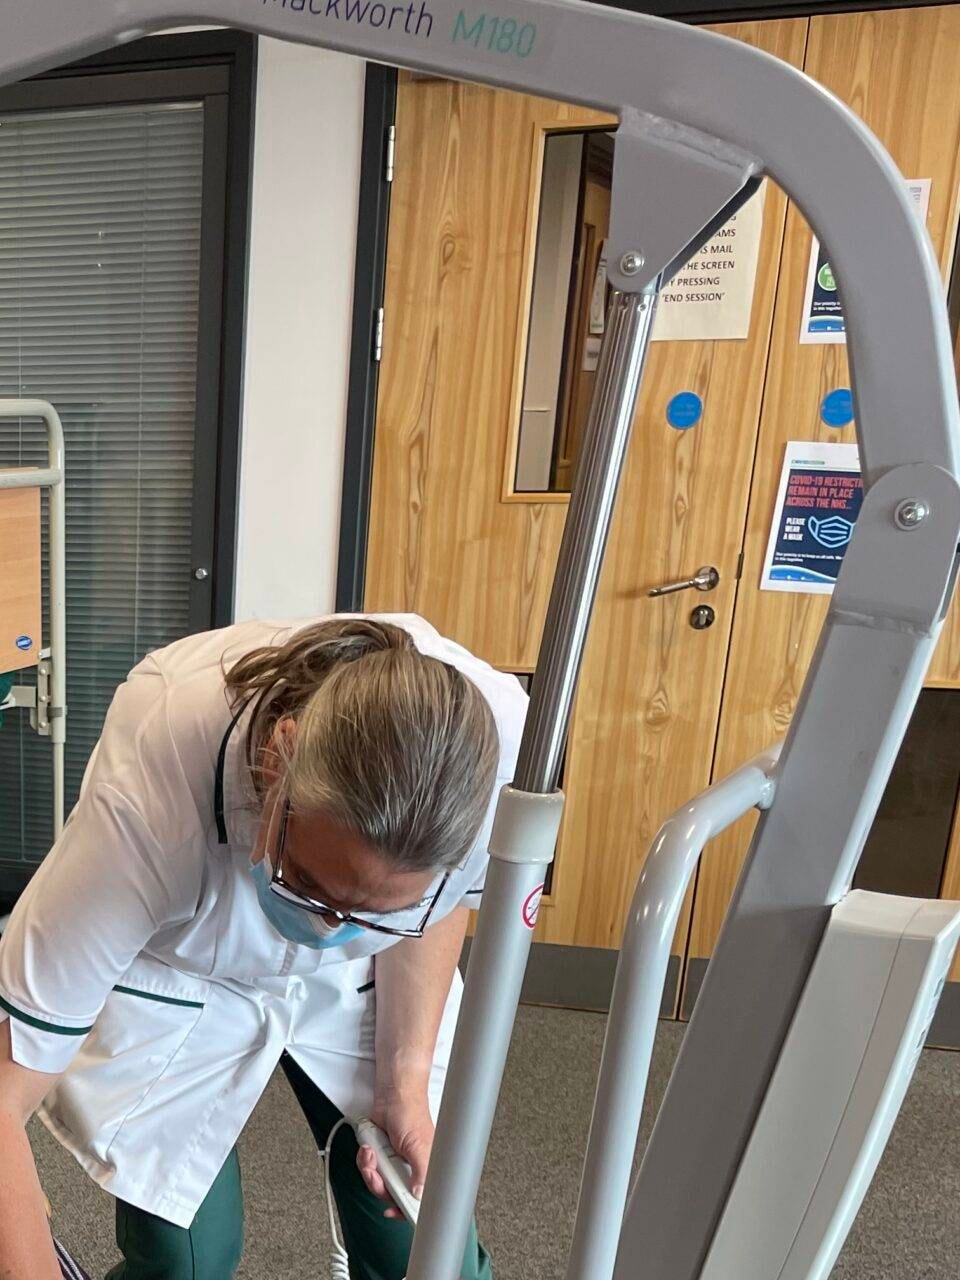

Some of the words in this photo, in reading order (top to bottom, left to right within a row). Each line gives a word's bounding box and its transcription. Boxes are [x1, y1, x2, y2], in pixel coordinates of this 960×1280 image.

[263, 0, 433, 37] ackworth
[451, 9, 537, 58] M180
[710, 244, 733, 254] MAIL
[683, 262, 698, 271] HE
[701, 261, 735, 271] SCREEN
[677, 277, 720, 287] PRESSING
[789, 475, 824, 486] COVID-19
[788, 485, 818, 497] REMAIN
[819, 487, 828, 497] IN
[829, 487, 854, 498] PLACE
[785, 496, 815, 507] ACROSS
[816, 498, 830, 508] THE
